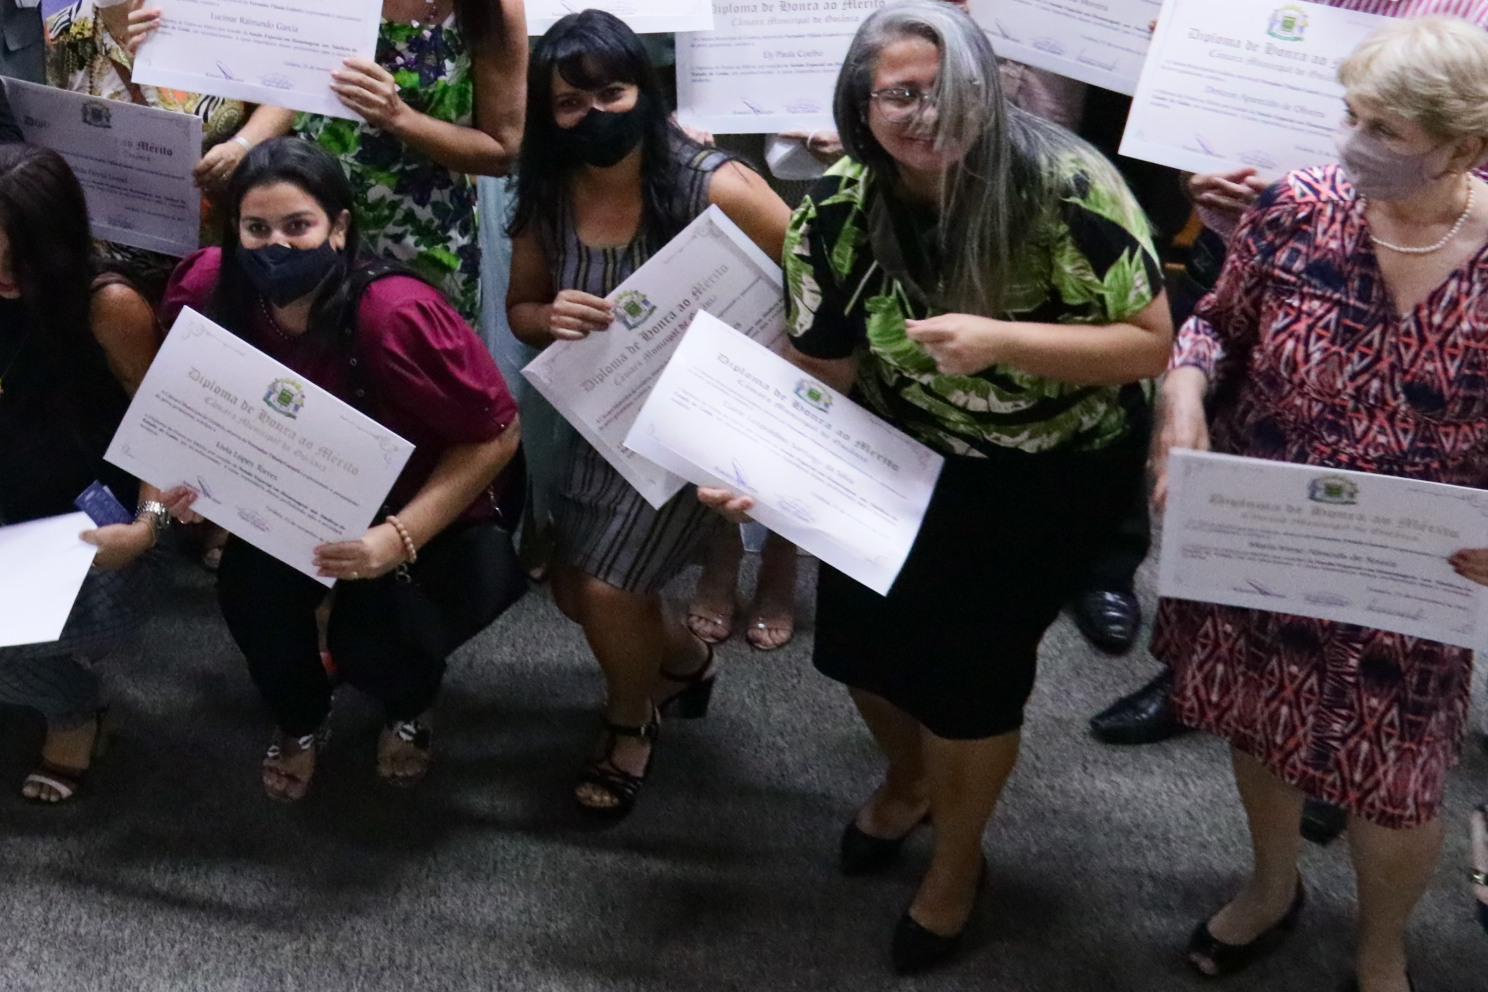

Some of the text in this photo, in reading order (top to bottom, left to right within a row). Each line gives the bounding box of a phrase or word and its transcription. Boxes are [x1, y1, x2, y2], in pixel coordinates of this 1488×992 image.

[762, 1, 775, 12] de
[780, 0, 820, 11] Honra
[824, 1, 838, 10] ao
[210, 11, 237, 23] Lucimar
[239, 16, 275, 29] Raimundo
[627, 340, 641, 354] de
[641, 309, 678, 341] Honra
[679, 297, 691, 312] ao
[188, 366, 359, 475] Diploma de Honra ao Mérito
[255, 463, 279, 481] Torres
